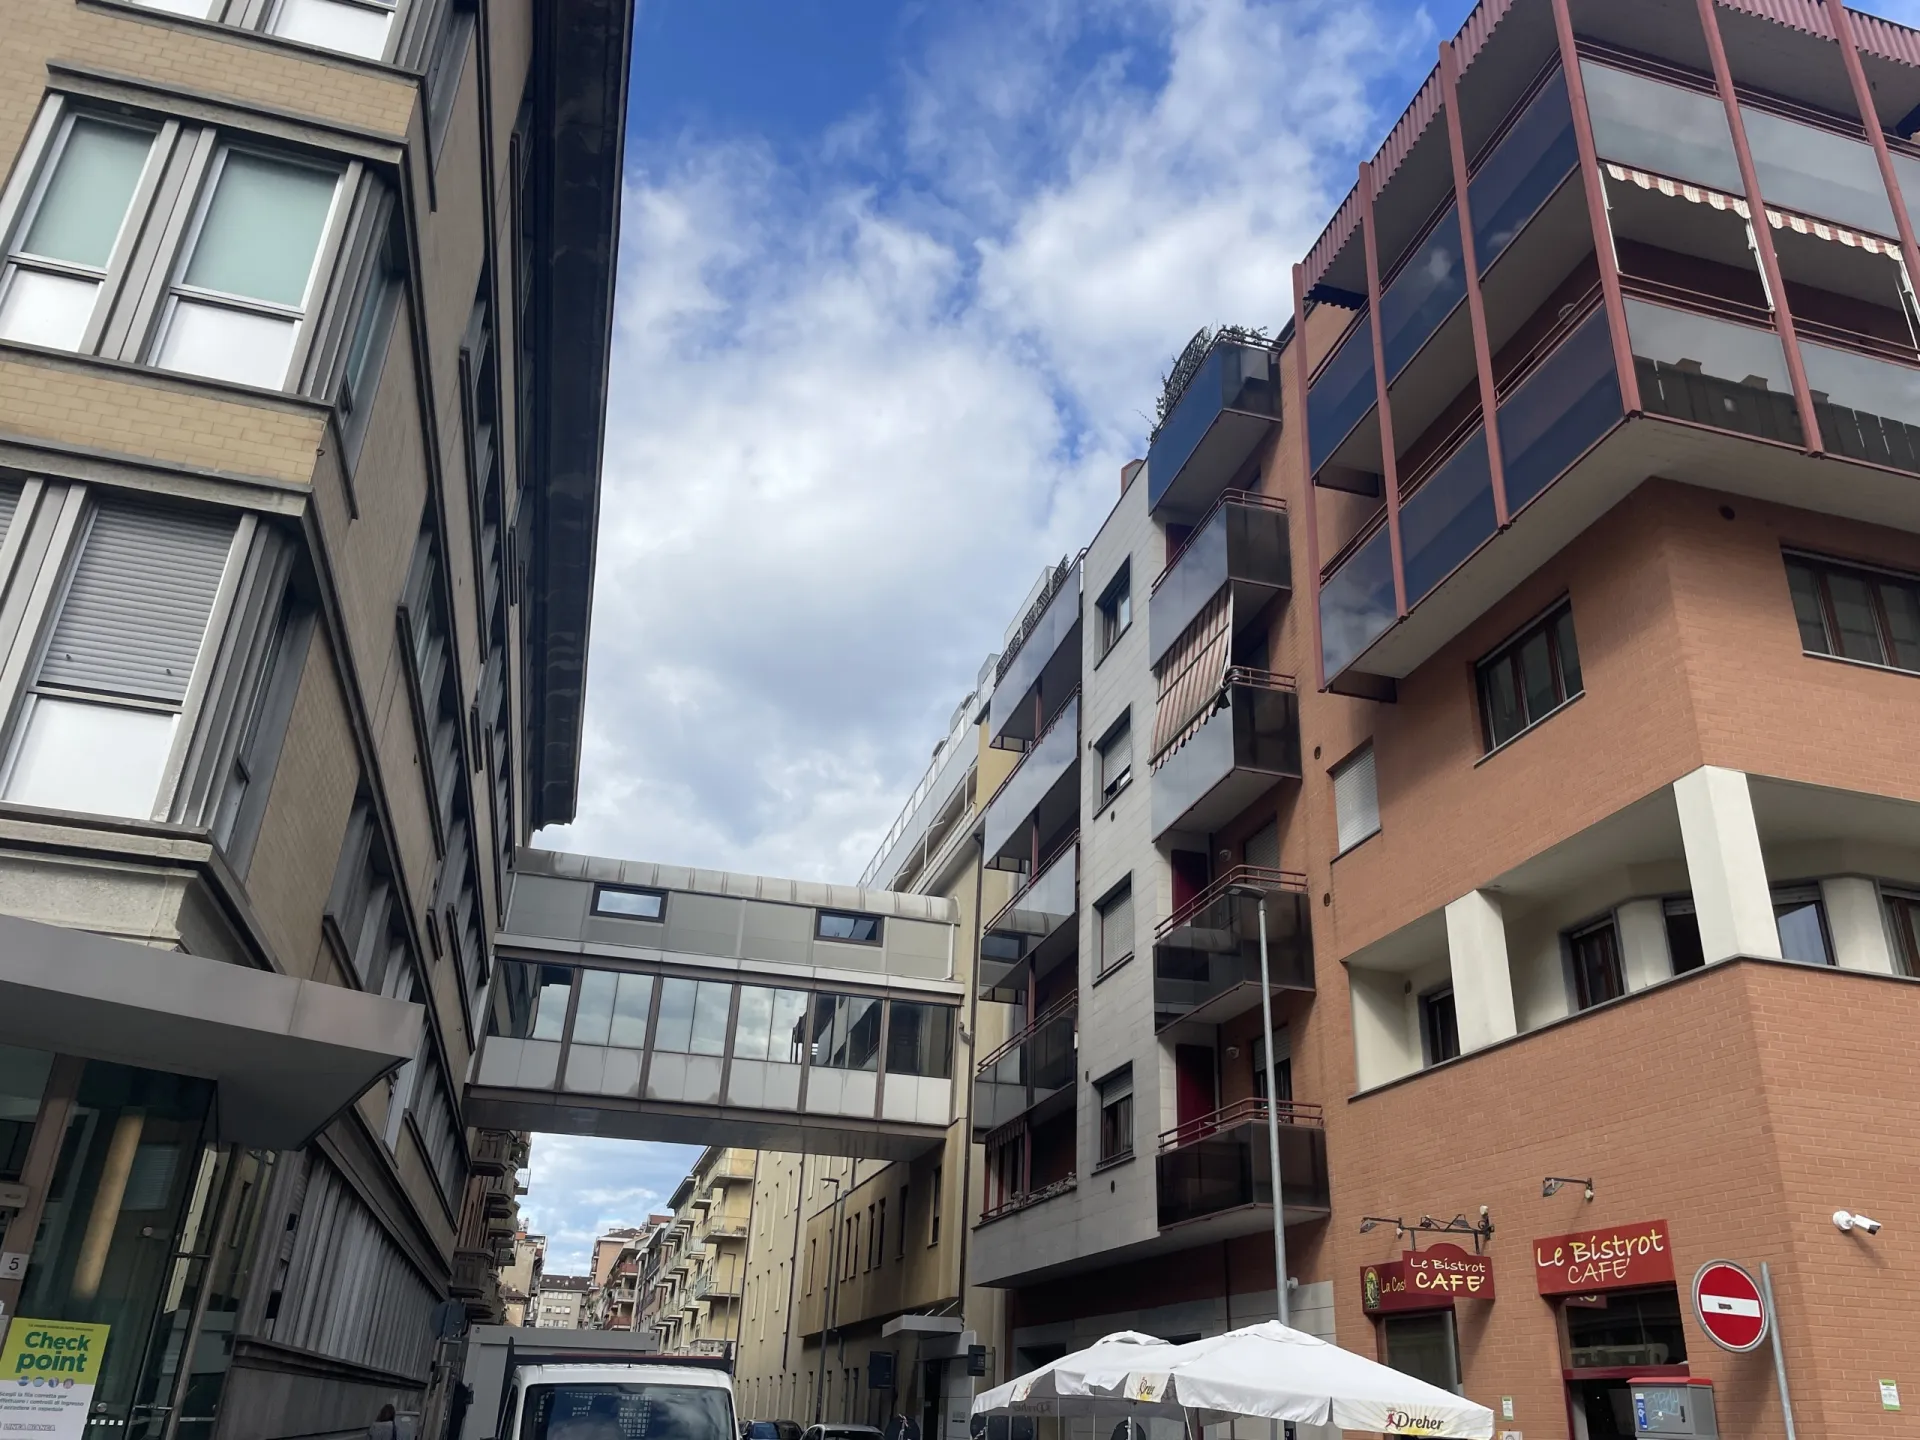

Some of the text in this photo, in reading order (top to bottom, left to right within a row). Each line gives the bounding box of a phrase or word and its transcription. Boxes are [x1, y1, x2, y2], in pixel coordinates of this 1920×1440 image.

[1537, 1229, 1664, 1267] Le Bistrot
[9, 1257, 20, 1271] 5
[1410, 1257, 1486, 1273] Le Bistrot
[1567, 1258, 1630, 1284] CAFE'
[1380, 1277, 1391, 1294] La
[1415, 1271, 1485, 1292] CAFE'
[25, 1331, 91, 1352] Check
[15, 1350, 88, 1373] point
[1396, 1411, 1445, 1430] Dreher
